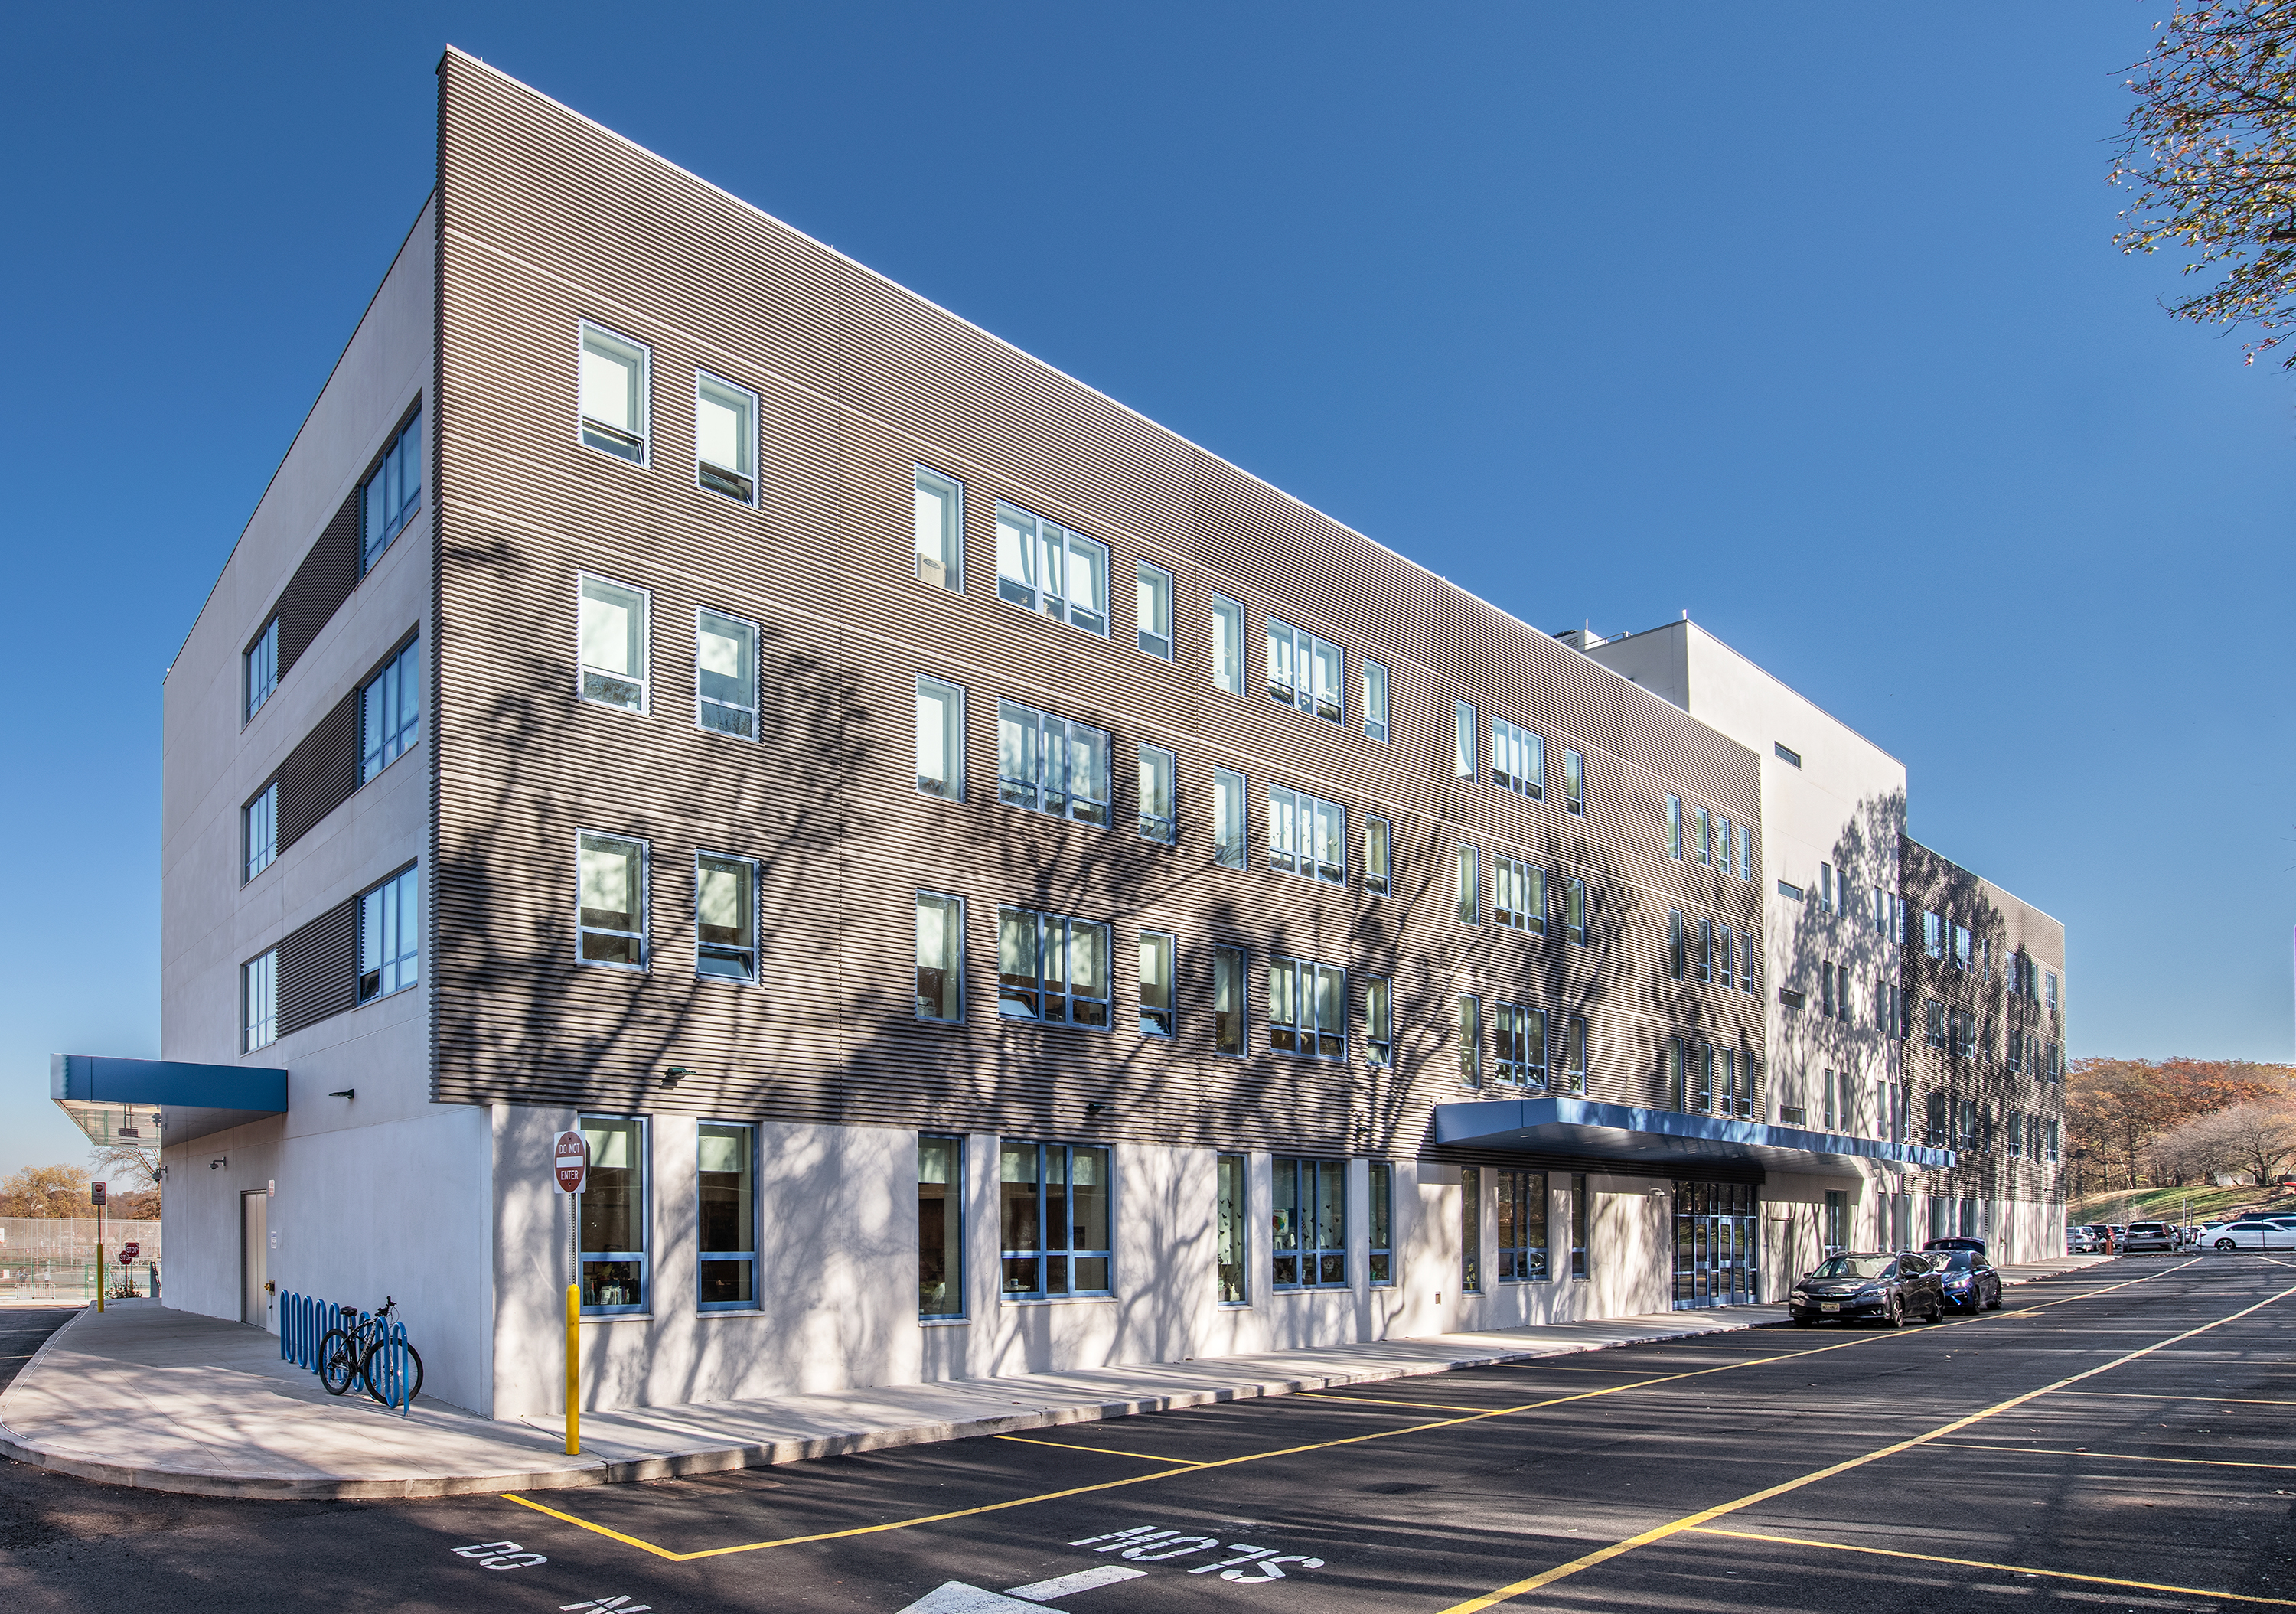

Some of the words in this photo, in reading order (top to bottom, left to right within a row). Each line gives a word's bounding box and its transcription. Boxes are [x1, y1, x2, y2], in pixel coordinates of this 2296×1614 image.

[559, 1144, 567, 1154] DO
[569, 1143, 580, 1153] NOT
[561, 1169, 579, 1180] ENTER
[450, 1541, 548, 1570] DO
[1067, 1525, 1325, 1583] SLOW
